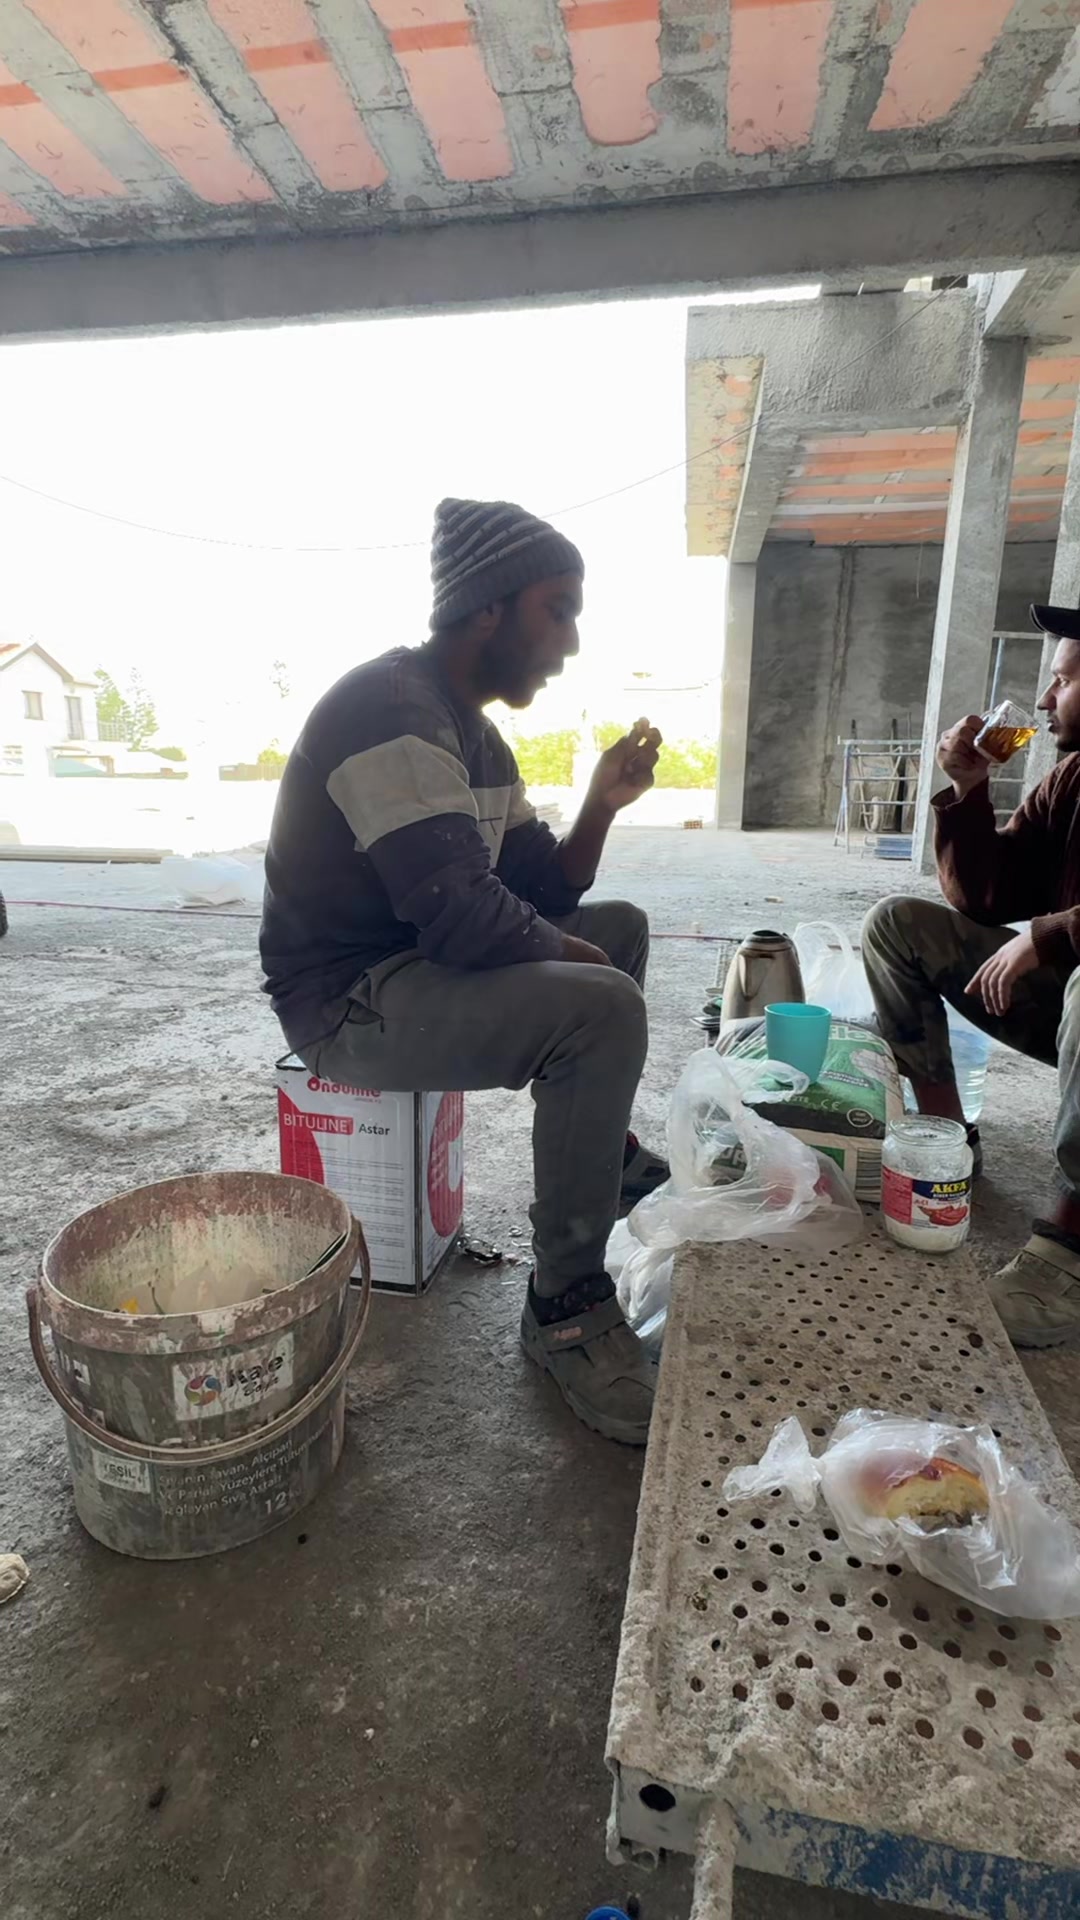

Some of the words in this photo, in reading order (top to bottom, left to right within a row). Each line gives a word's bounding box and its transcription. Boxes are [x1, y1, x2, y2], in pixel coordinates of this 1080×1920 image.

[283, 1113, 348, 1133] BITULINE
[359, 1123, 390, 1136] Astar
[211, 1464, 249, 1480] avan,
[265, 1490, 287, 1515] 12
